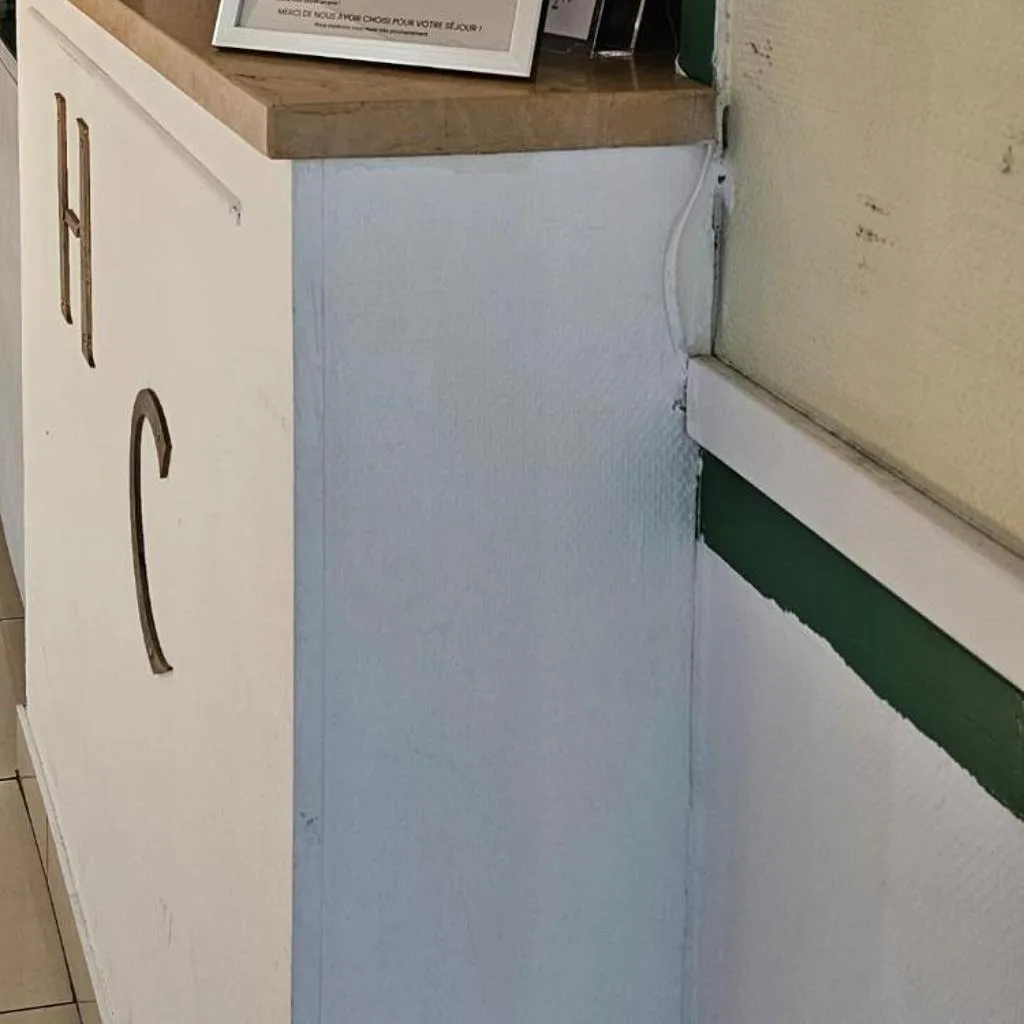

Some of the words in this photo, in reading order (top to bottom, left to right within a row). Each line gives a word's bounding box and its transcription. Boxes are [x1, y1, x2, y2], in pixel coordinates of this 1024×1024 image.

[278, 8, 301, 16] MERCI
[314, 11, 336, 20] NOUS
[337, 12, 361, 22] AVOIR
[363, 14, 391, 24] CHOISI
[392, 17, 415, 26] POUR
[416, 19, 443, 29] VOTRE
[444, 20, 478, 33] SÉJOUR
